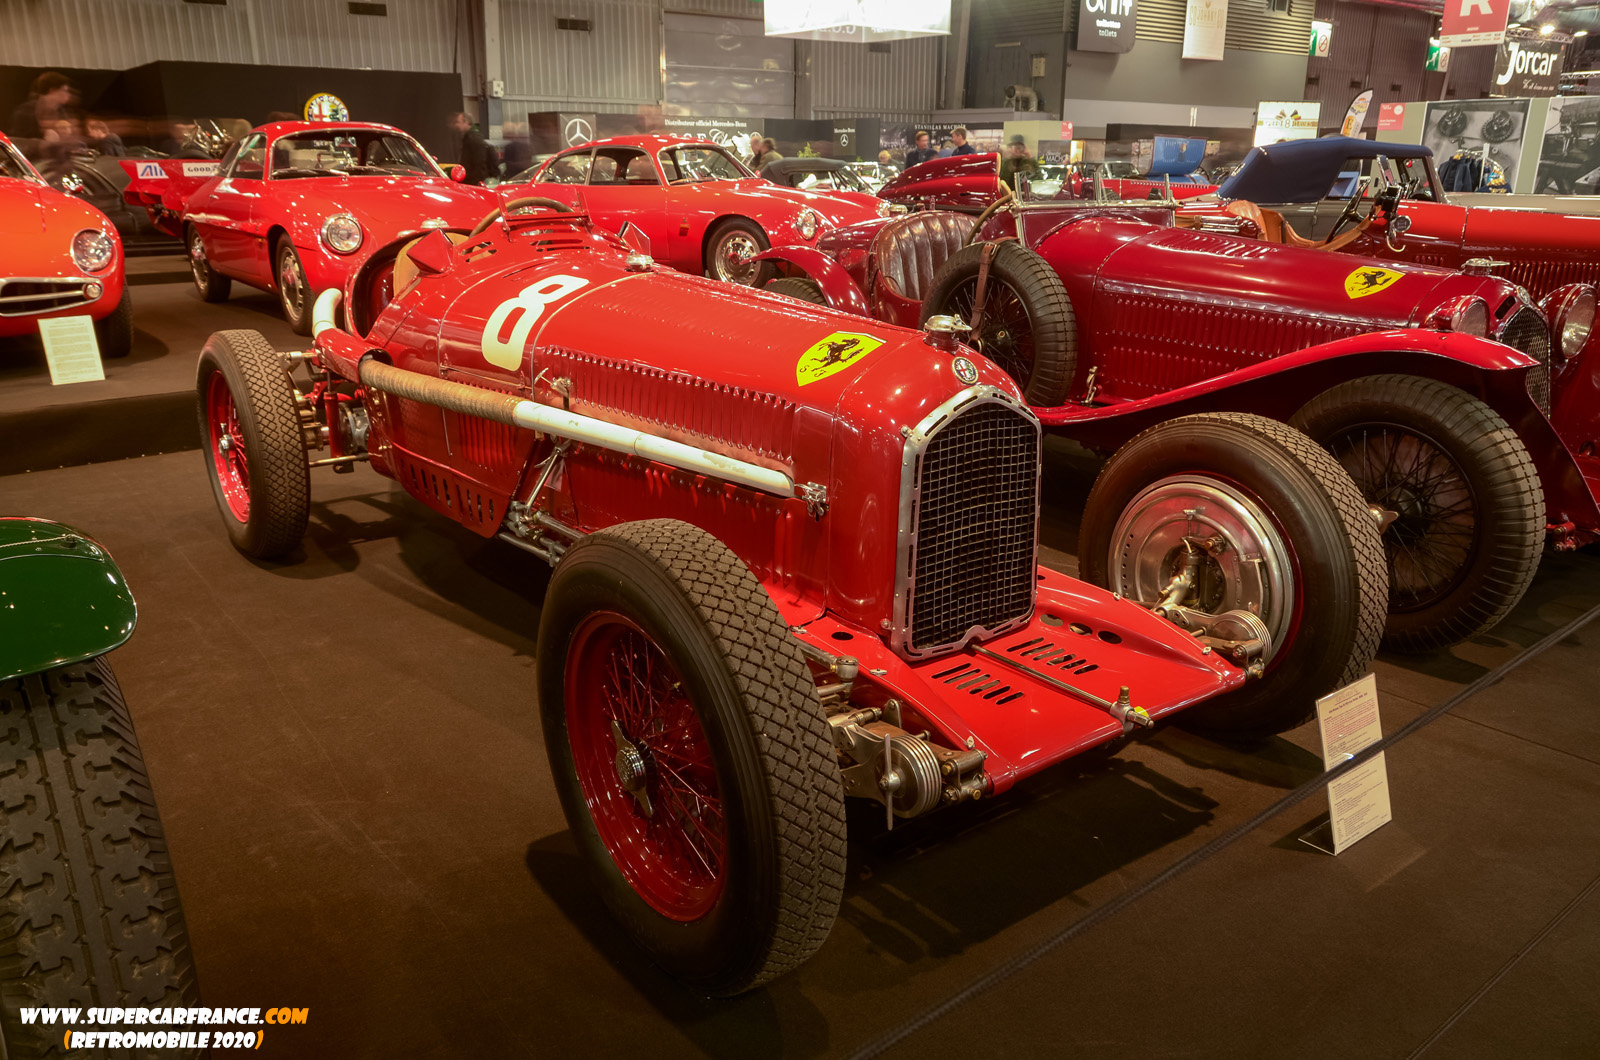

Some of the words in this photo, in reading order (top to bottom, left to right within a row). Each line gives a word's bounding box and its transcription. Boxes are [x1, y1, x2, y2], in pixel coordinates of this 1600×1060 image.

[1098, 29, 1117, 37] toilets
[1496, 41, 1558, 85] Jorcar
[664, 119, 695, 127] Distributeur
[696, 119, 711, 127] officiel
[712, 120, 747, 128] Mercedes-Benz
[481, 274, 590, 372] 8
